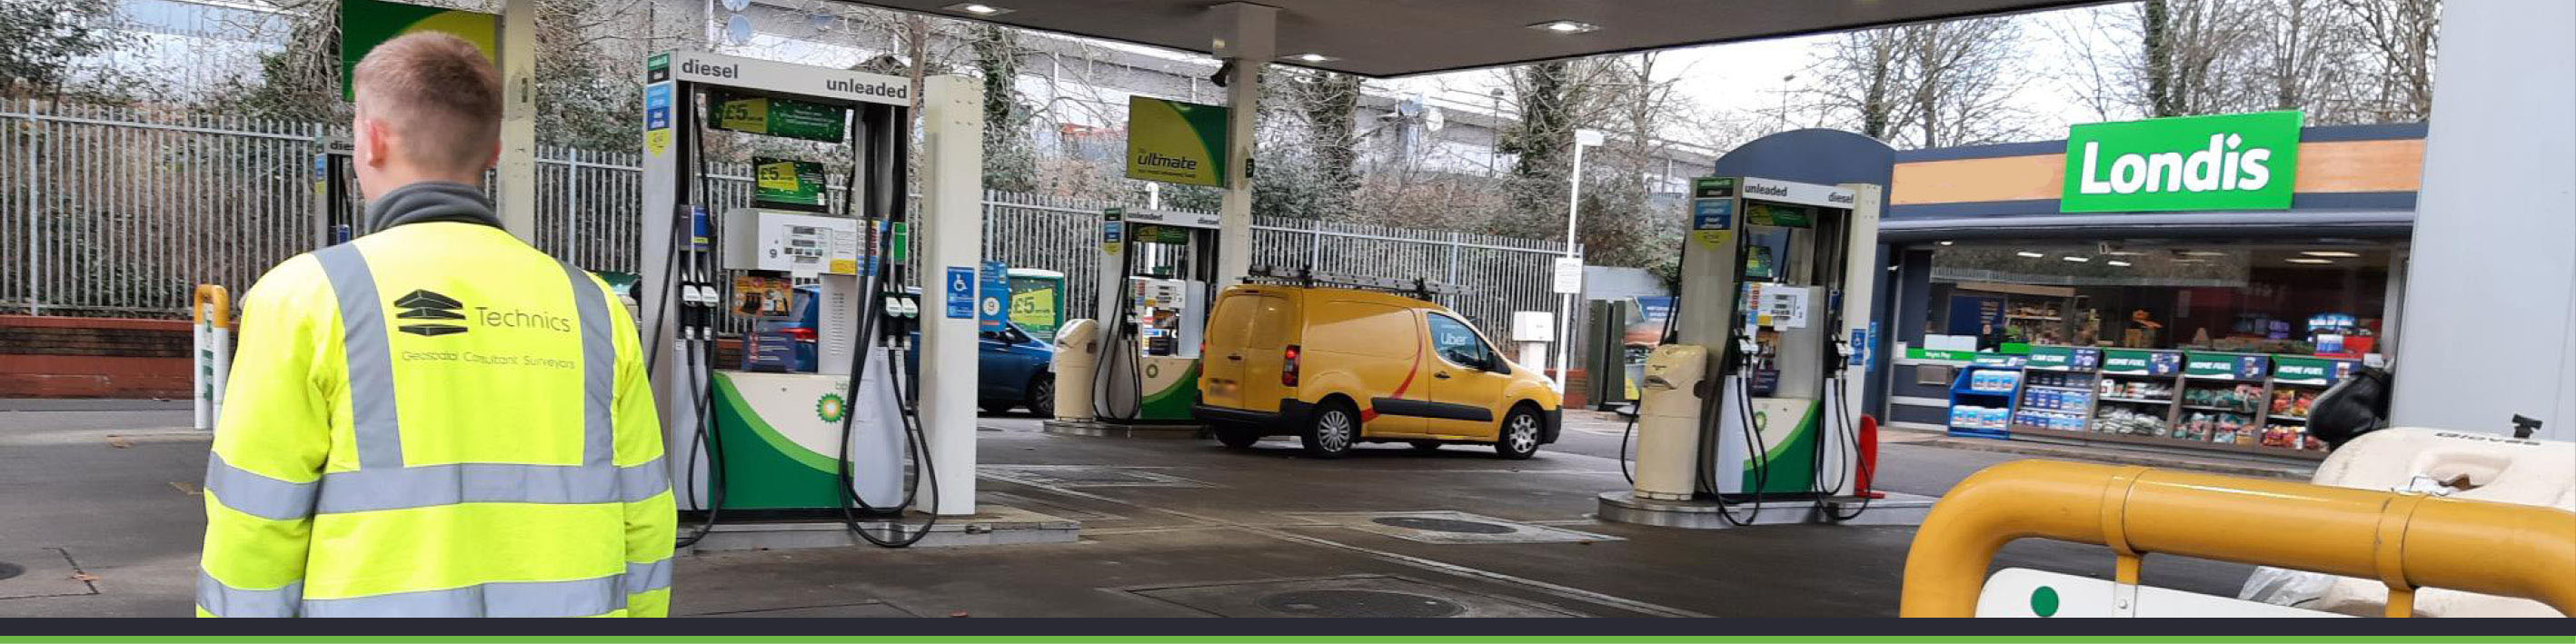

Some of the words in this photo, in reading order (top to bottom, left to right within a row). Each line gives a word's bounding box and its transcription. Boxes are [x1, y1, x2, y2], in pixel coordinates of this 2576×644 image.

[681, 59, 739, 79] diesel
[826, 78, 908, 99] unleaded
[2080, 133, 2272, 194] Londis
[761, 166, 780, 181] £5
[1745, 183, 1788, 197] unleaded
[1828, 191, 1855, 203] diesel
[1013, 296, 1035, 315] £5
[475, 306, 572, 333] Technics
[1440, 332, 1468, 345] Uber
[2106, 358, 2129, 366] HOME
[2128, 359, 2145, 367] FUEL
[2189, 362, 2213, 370] HOME
[2213, 362, 2232, 371] FUEL
[2278, 365, 2303, 374] HOME
[2302, 367, 2323, 375] FUEL
